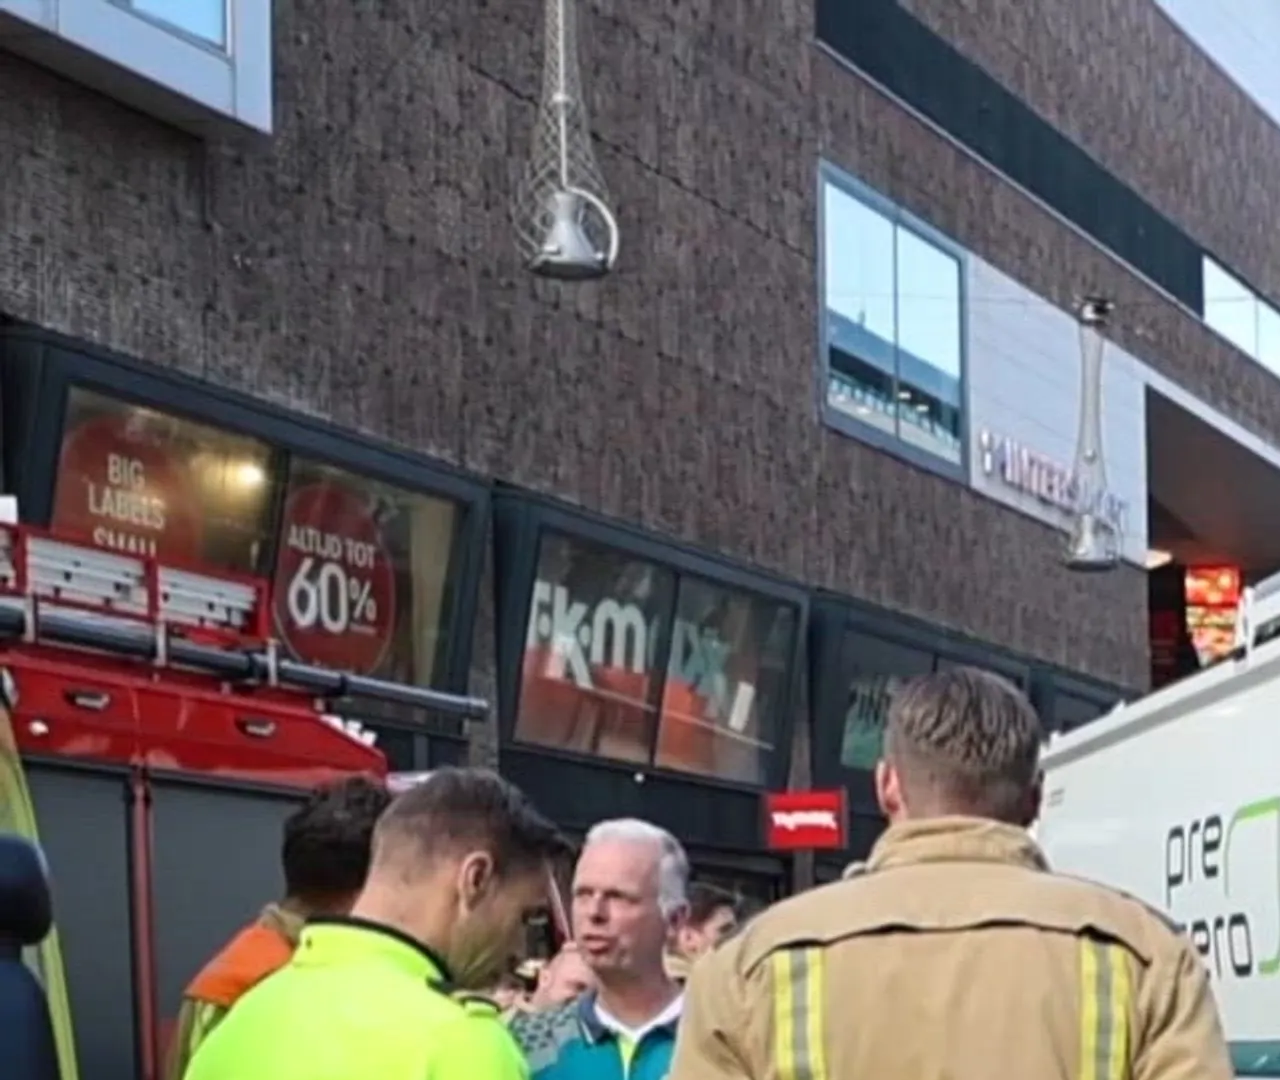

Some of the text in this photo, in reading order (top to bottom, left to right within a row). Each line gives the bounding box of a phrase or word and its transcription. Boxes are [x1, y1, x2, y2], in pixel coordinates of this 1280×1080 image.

[107, 452, 146, 492] BIG
[88, 480, 166, 531] LABELS
[288, 524, 376, 570] ALTIJD TOT
[287, 556, 378, 635] 60%
[1166, 814, 1223, 909] pre
[1170, 911, 1254, 978] ero
